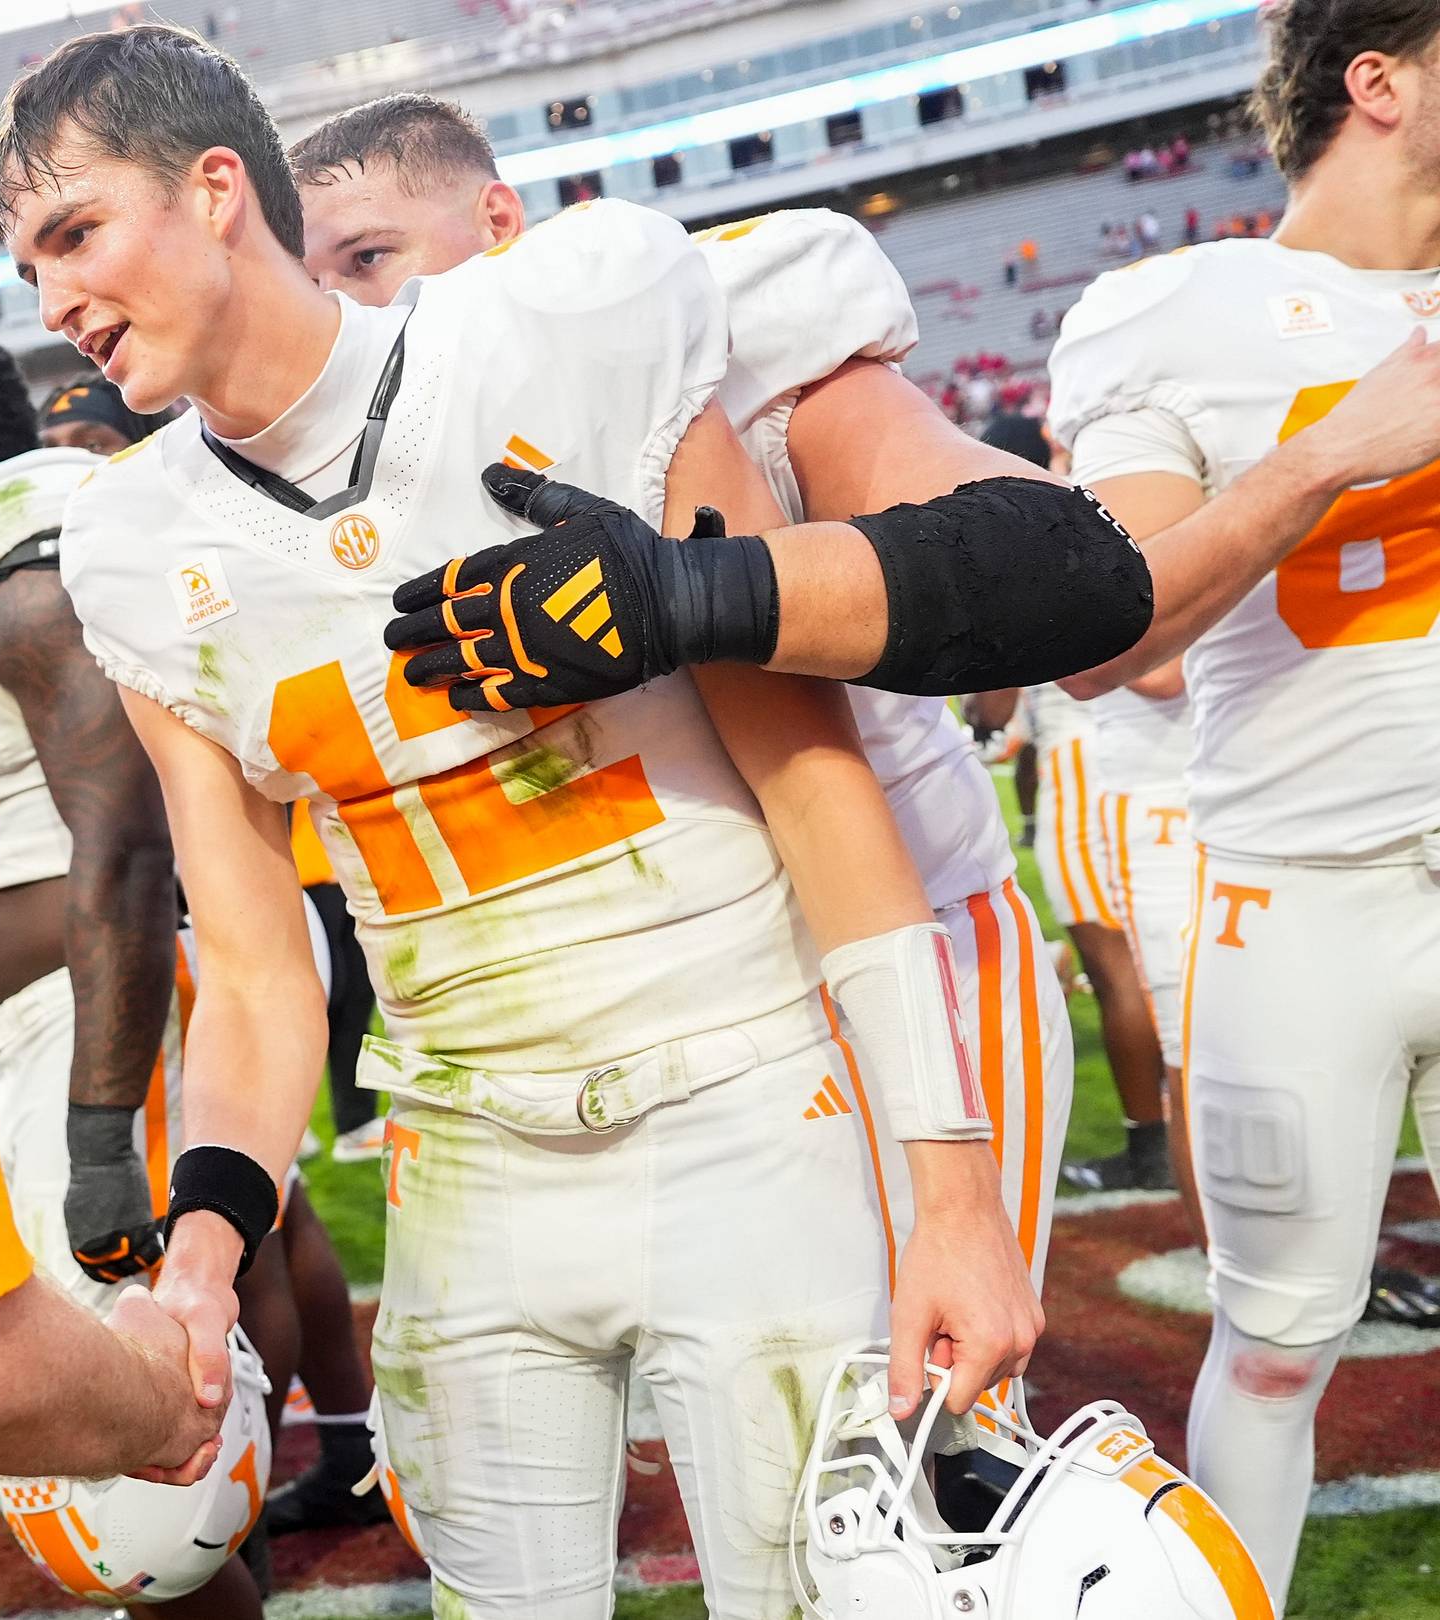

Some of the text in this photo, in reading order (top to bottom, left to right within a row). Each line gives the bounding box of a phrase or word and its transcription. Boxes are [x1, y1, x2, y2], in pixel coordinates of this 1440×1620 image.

[333, 516, 377, 568] SEC
[185, 599, 231, 626] HORIZON
[190, 592, 216, 610] FIRST
[267, 649, 667, 917] 12
[1212, 881, 1272, 949] T
